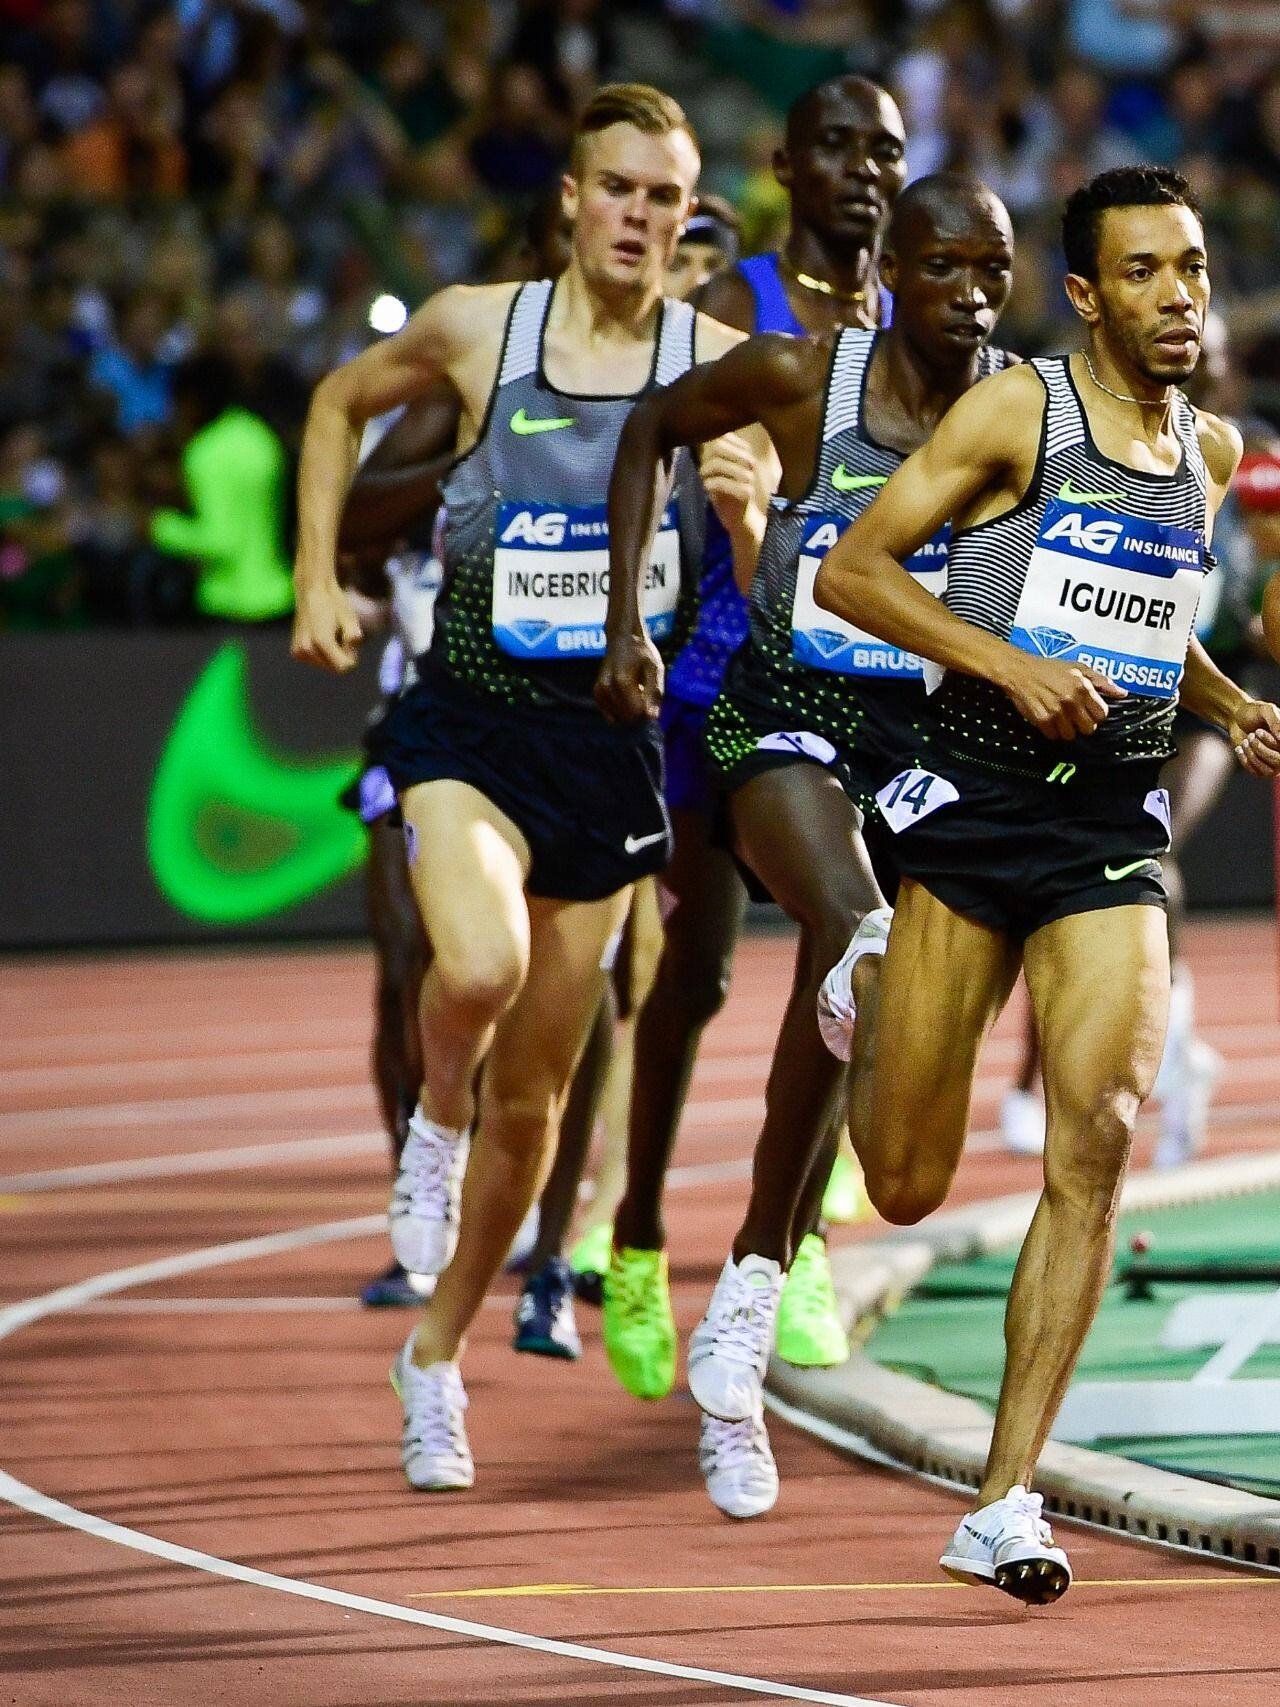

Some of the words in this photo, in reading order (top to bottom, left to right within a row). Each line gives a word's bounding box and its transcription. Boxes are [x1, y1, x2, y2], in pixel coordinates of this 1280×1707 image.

[501, 511, 568, 546] AG
[1042, 513, 1124, 555] AG
[1124, 537, 1199, 564] INSURANCE
[1059, 578, 1176, 631] IGUIDER
[885, 771, 936, 815] 14
